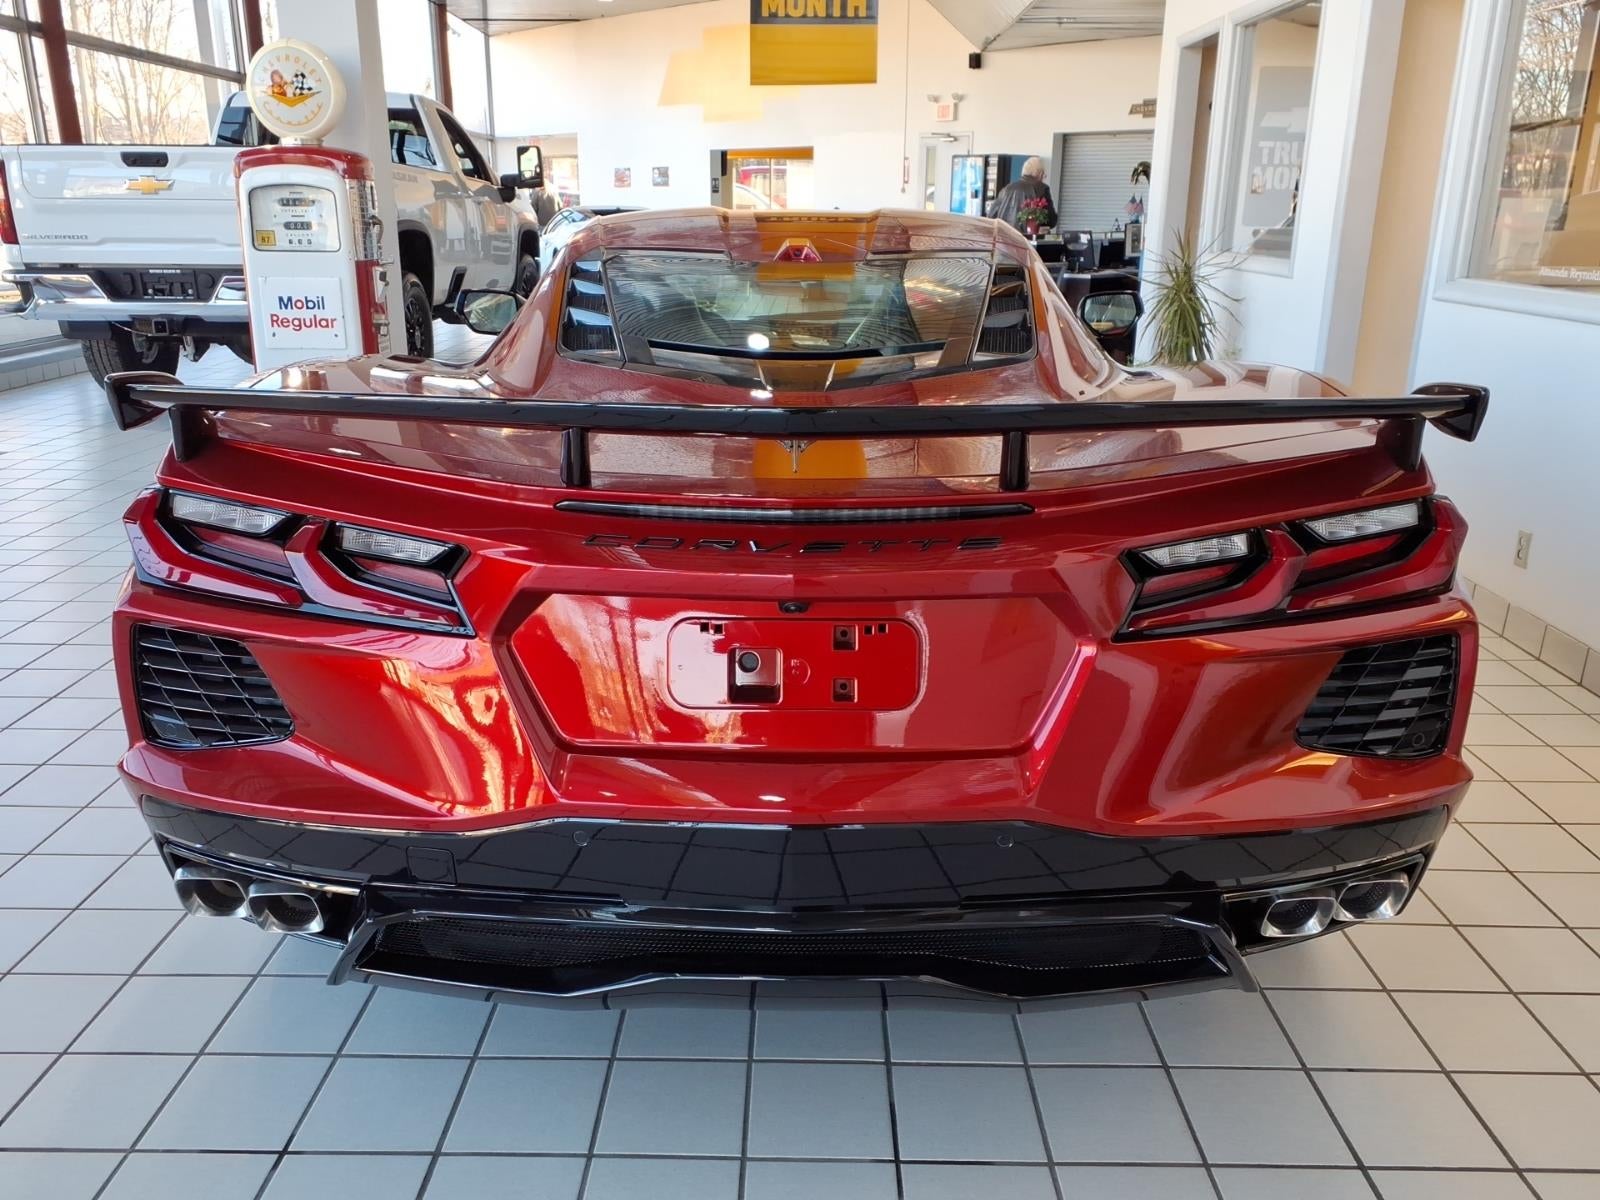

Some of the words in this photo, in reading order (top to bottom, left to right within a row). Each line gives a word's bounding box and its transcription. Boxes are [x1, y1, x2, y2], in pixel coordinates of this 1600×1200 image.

[762, 0, 867, 17] MONTH
[278, 296, 325, 310] Mobil
[270, 314, 337, 332] Regular
[582, 534, 1003, 553] CORVETTE
